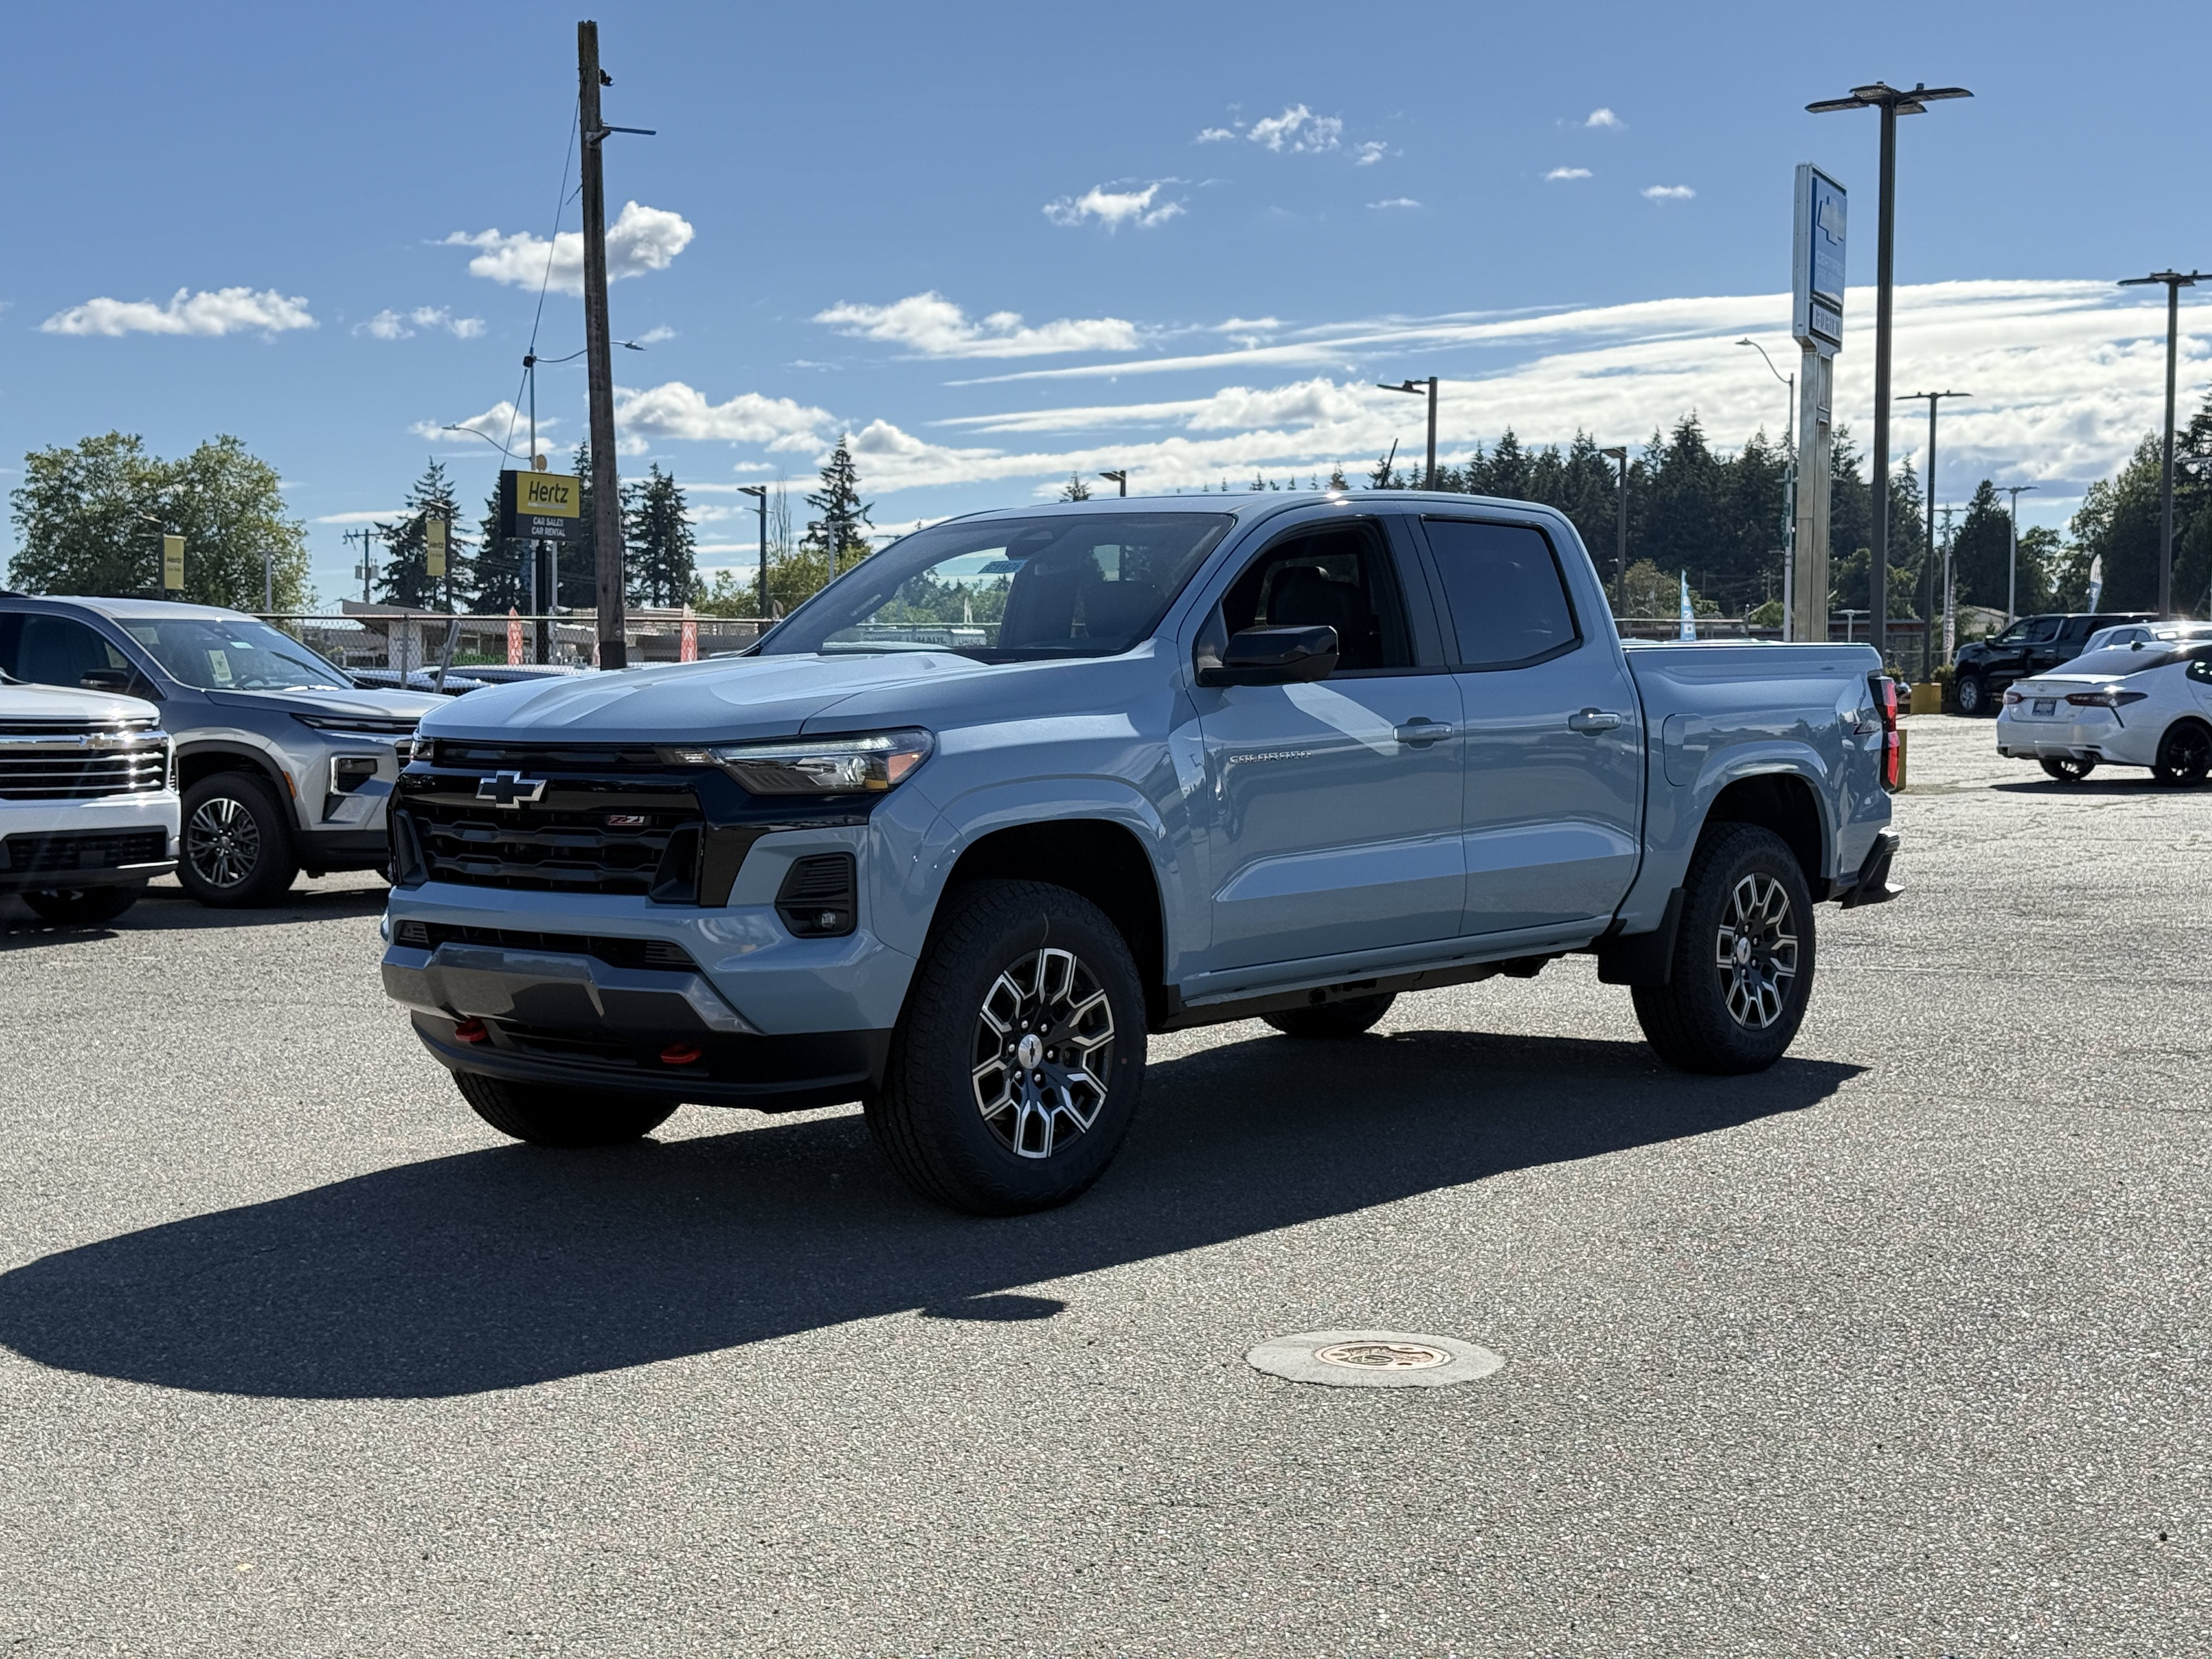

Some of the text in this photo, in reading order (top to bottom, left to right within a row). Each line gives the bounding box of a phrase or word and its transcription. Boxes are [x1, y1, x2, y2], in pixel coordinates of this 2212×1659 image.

[528, 480, 569, 504] Hertz
[533, 516, 565, 527] CAR SALES
[531, 526, 567, 537] CAR RENTAL
[1229, 751, 1312, 764] COLORADO
[608, 815, 645, 826] Z71
